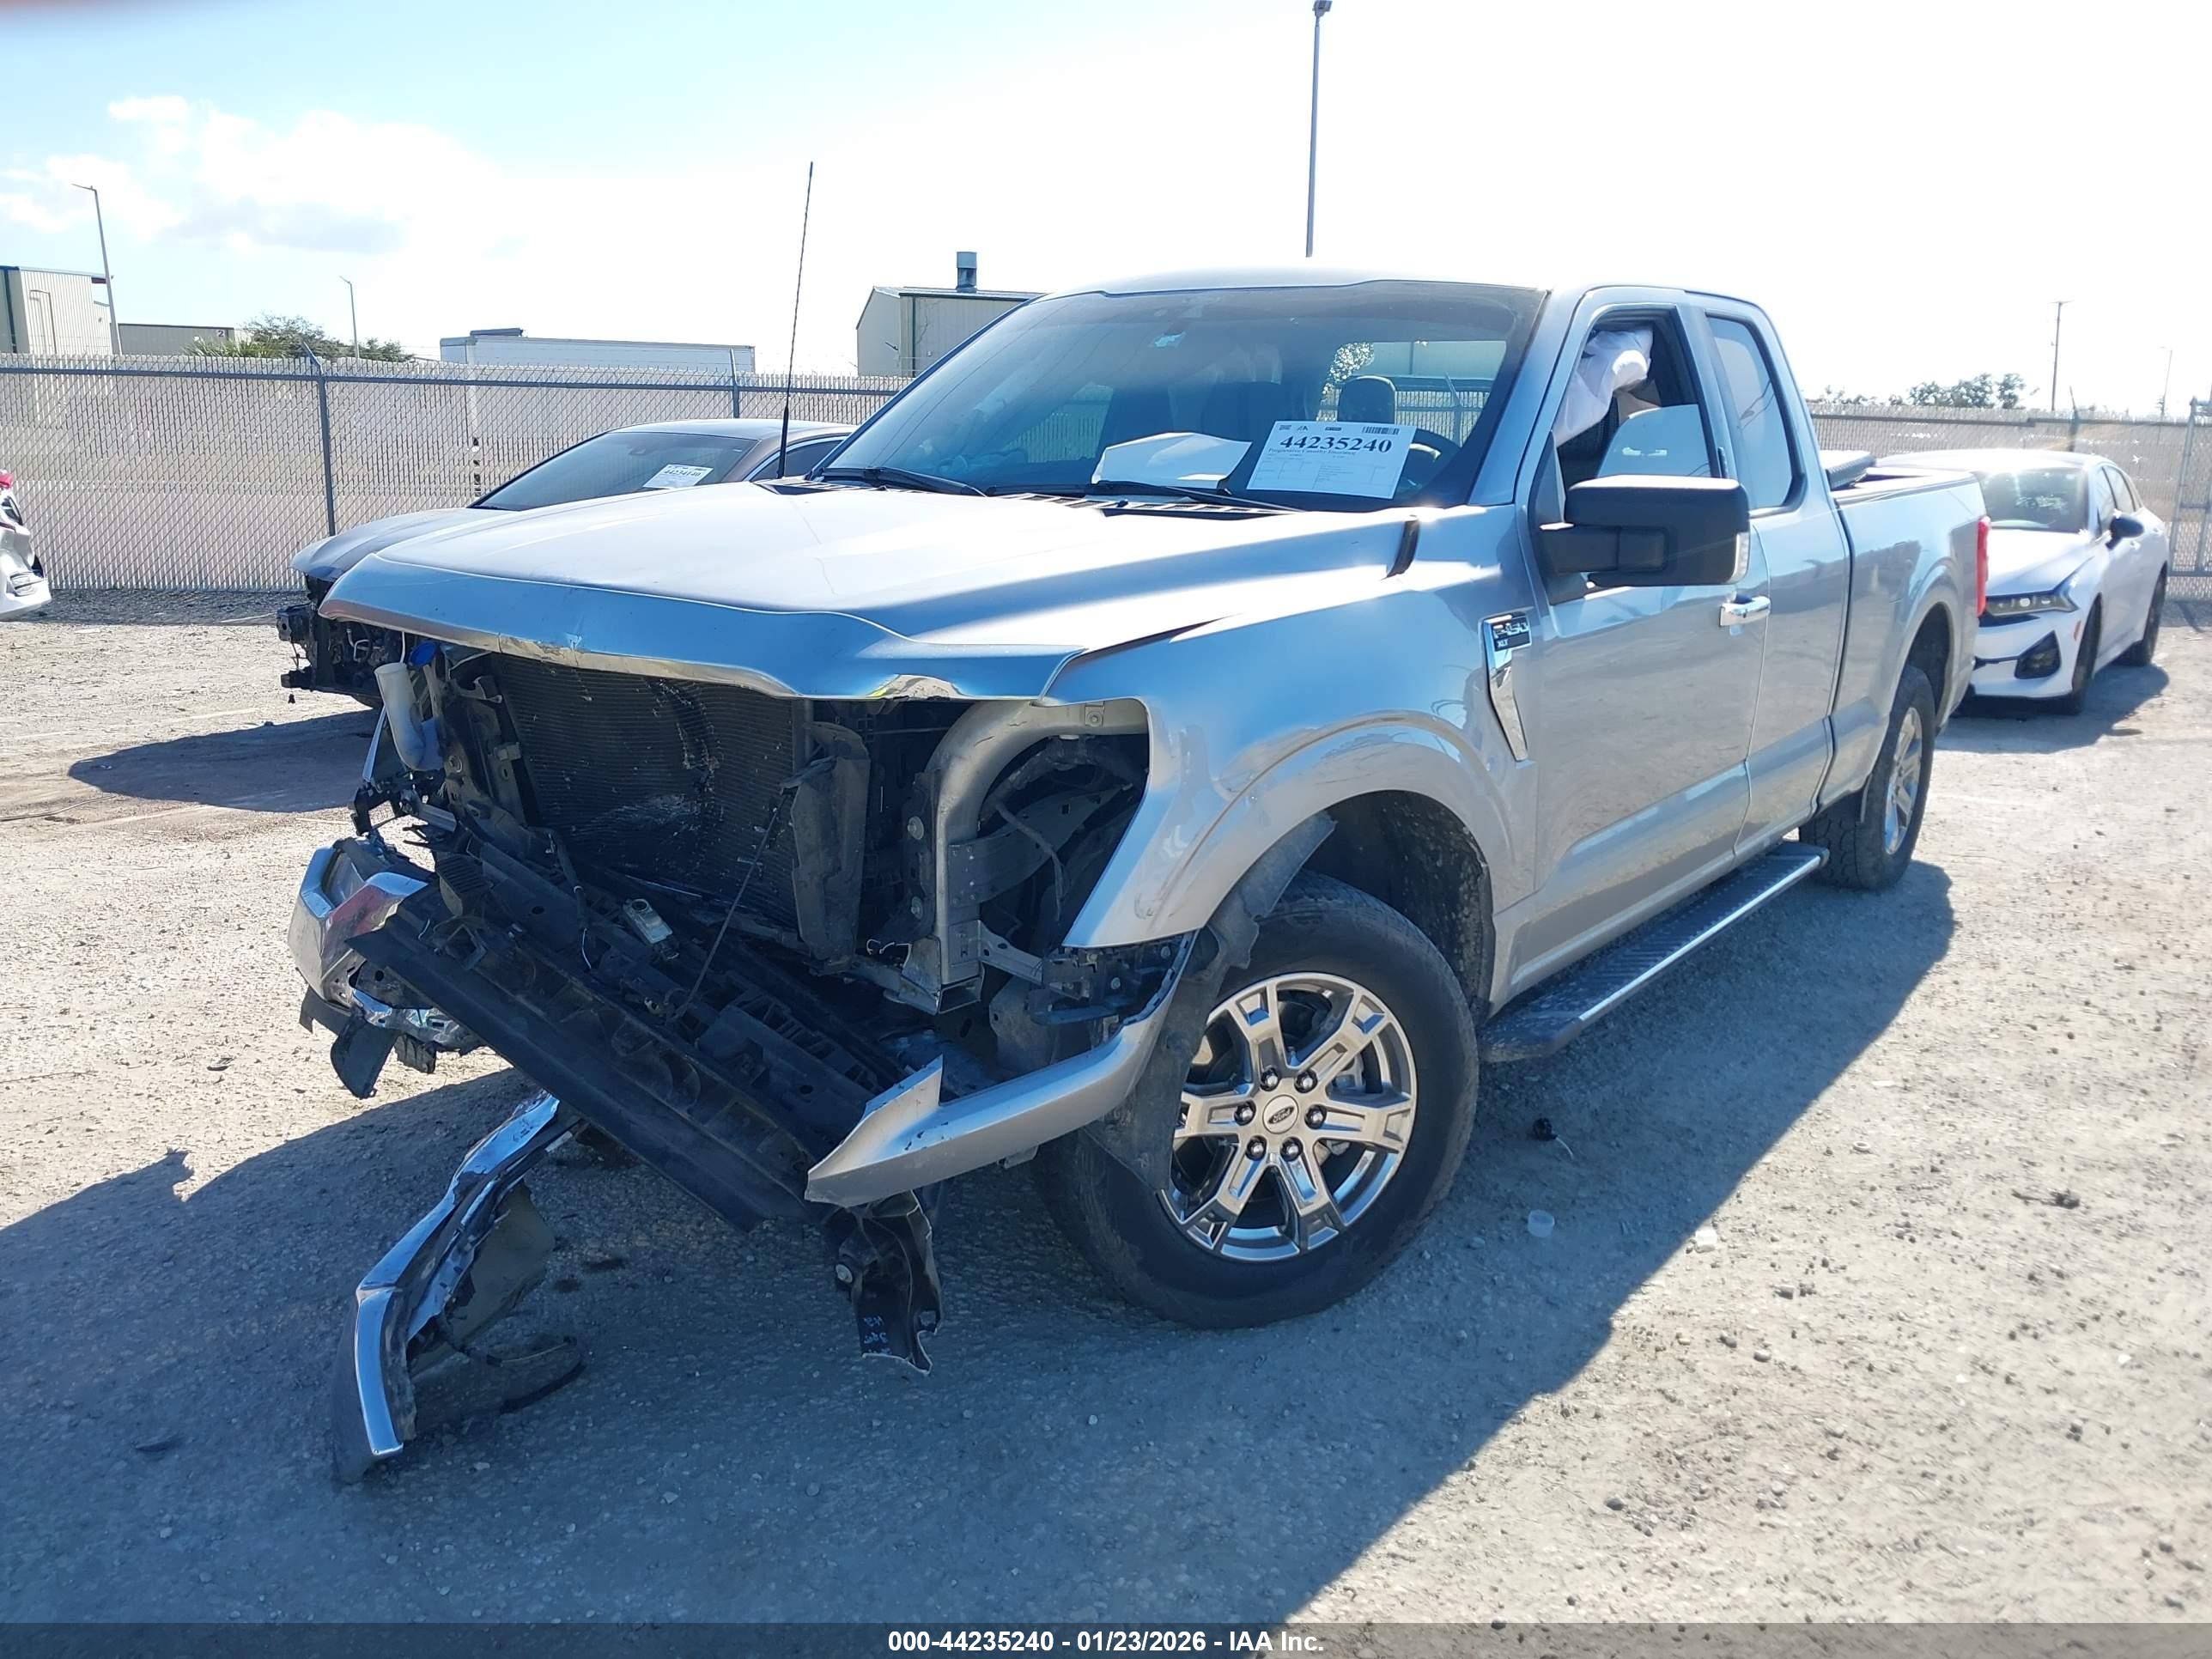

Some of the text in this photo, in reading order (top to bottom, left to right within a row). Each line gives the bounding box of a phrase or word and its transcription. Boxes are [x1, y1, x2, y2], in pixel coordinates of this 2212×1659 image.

[1279, 435, 1392, 453] 44235240
[1492, 622, 1529, 639] F-150
[1497, 638, 1509, 648] XLT
[1272, 1107, 1291, 1123] Ford
